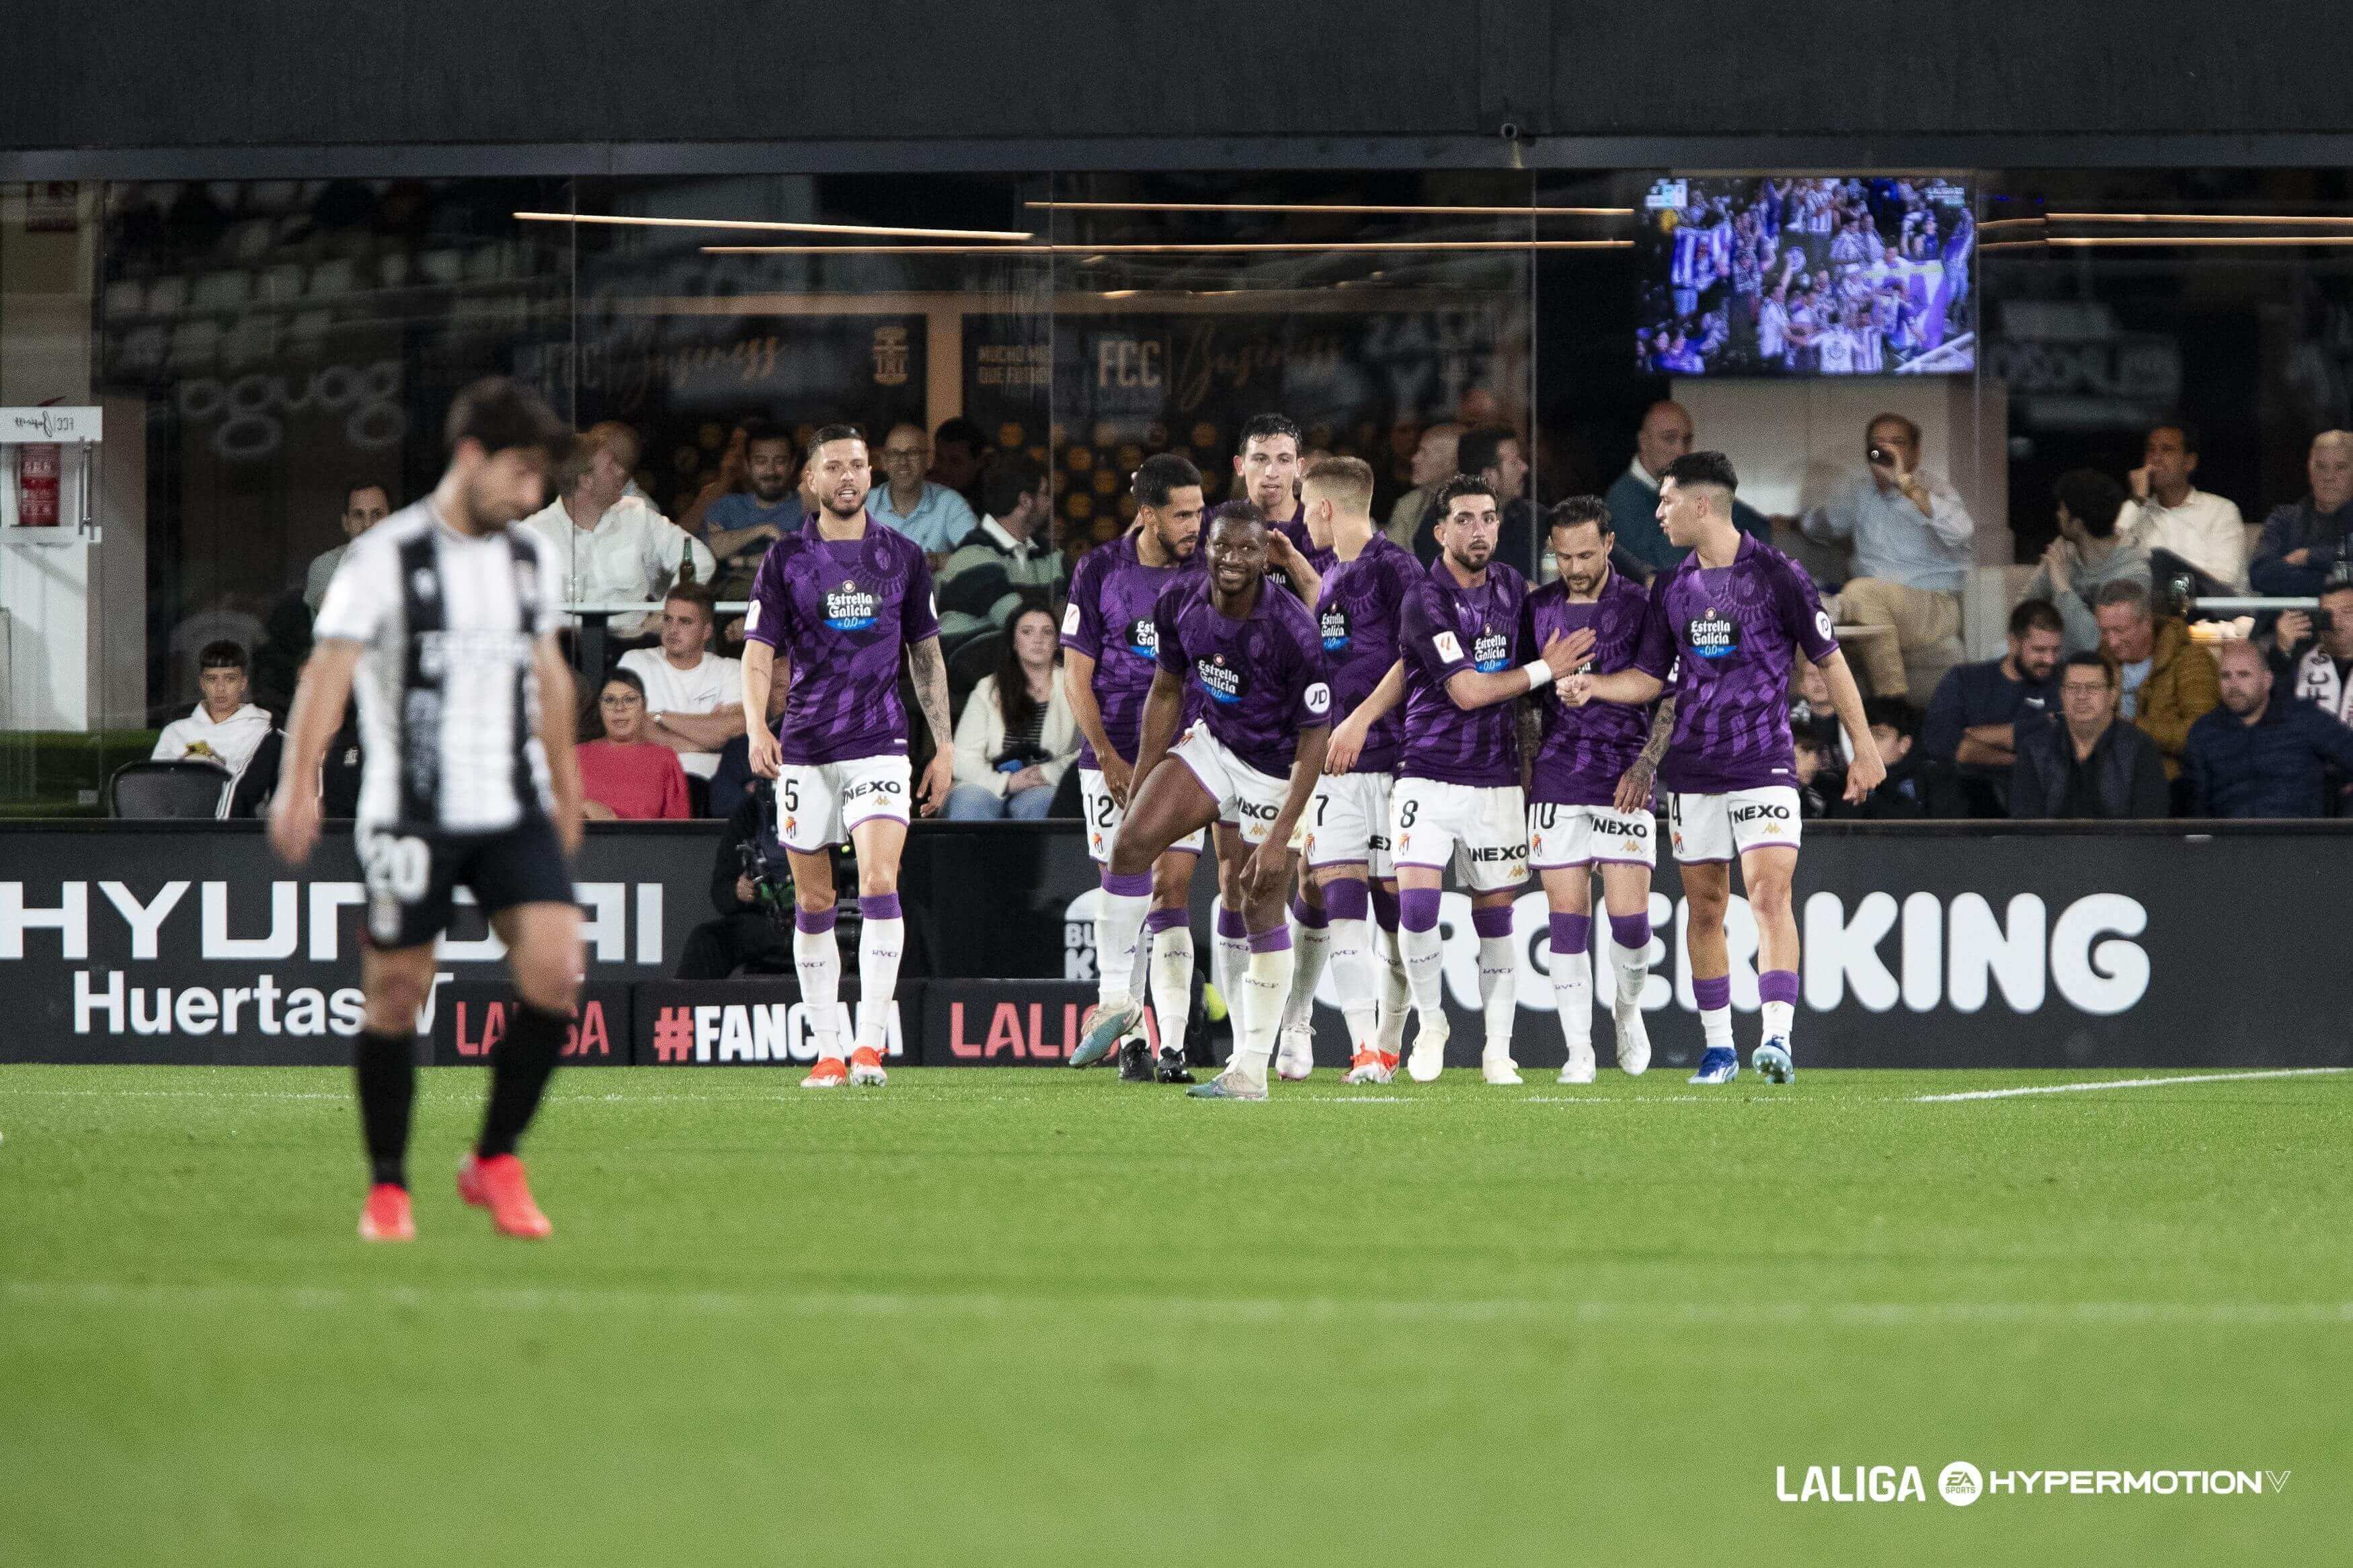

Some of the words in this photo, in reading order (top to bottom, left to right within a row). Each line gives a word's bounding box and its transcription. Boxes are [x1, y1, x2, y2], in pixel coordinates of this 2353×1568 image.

[1099, 339, 1162, 388] FCC
[827, 592, 873, 606] Estrella
[829, 604, 872, 618] Galicia
[1321, 612, 1345, 624] Estrella
[1321, 624, 1345, 637] Galicia
[1690, 620, 1731, 633] Estrella
[1474, 634, 1507, 650] Estrella
[1692, 632, 1730, 645] Galicia
[1474, 646, 1506, 662] Galicia
[1198, 659, 1239, 684] Estrella
[1199, 671, 1236, 694] Galicia
[1310, 689, 1327, 706] JD
[785, 778, 799, 812] 5
[845, 780, 902, 801] NEXO
[1088, 794, 1115, 828] 12
[1316, 794, 1329, 826] 7
[1400, 799, 1419, 828] 8
[1733, 804, 1790, 824] NEXO
[1593, 817, 1648, 838] NEXO
[1472, 843, 1528, 862] NEXO
[370, 834, 430, 895] 20
[1212, 893, 1764, 1012] RGER
[1803, 891, 2151, 1016] KING
[74, 971, 366, 1036] Huertas
[455, 1000, 610, 1057] LAA
[951, 1001, 1160, 1060] LALI
